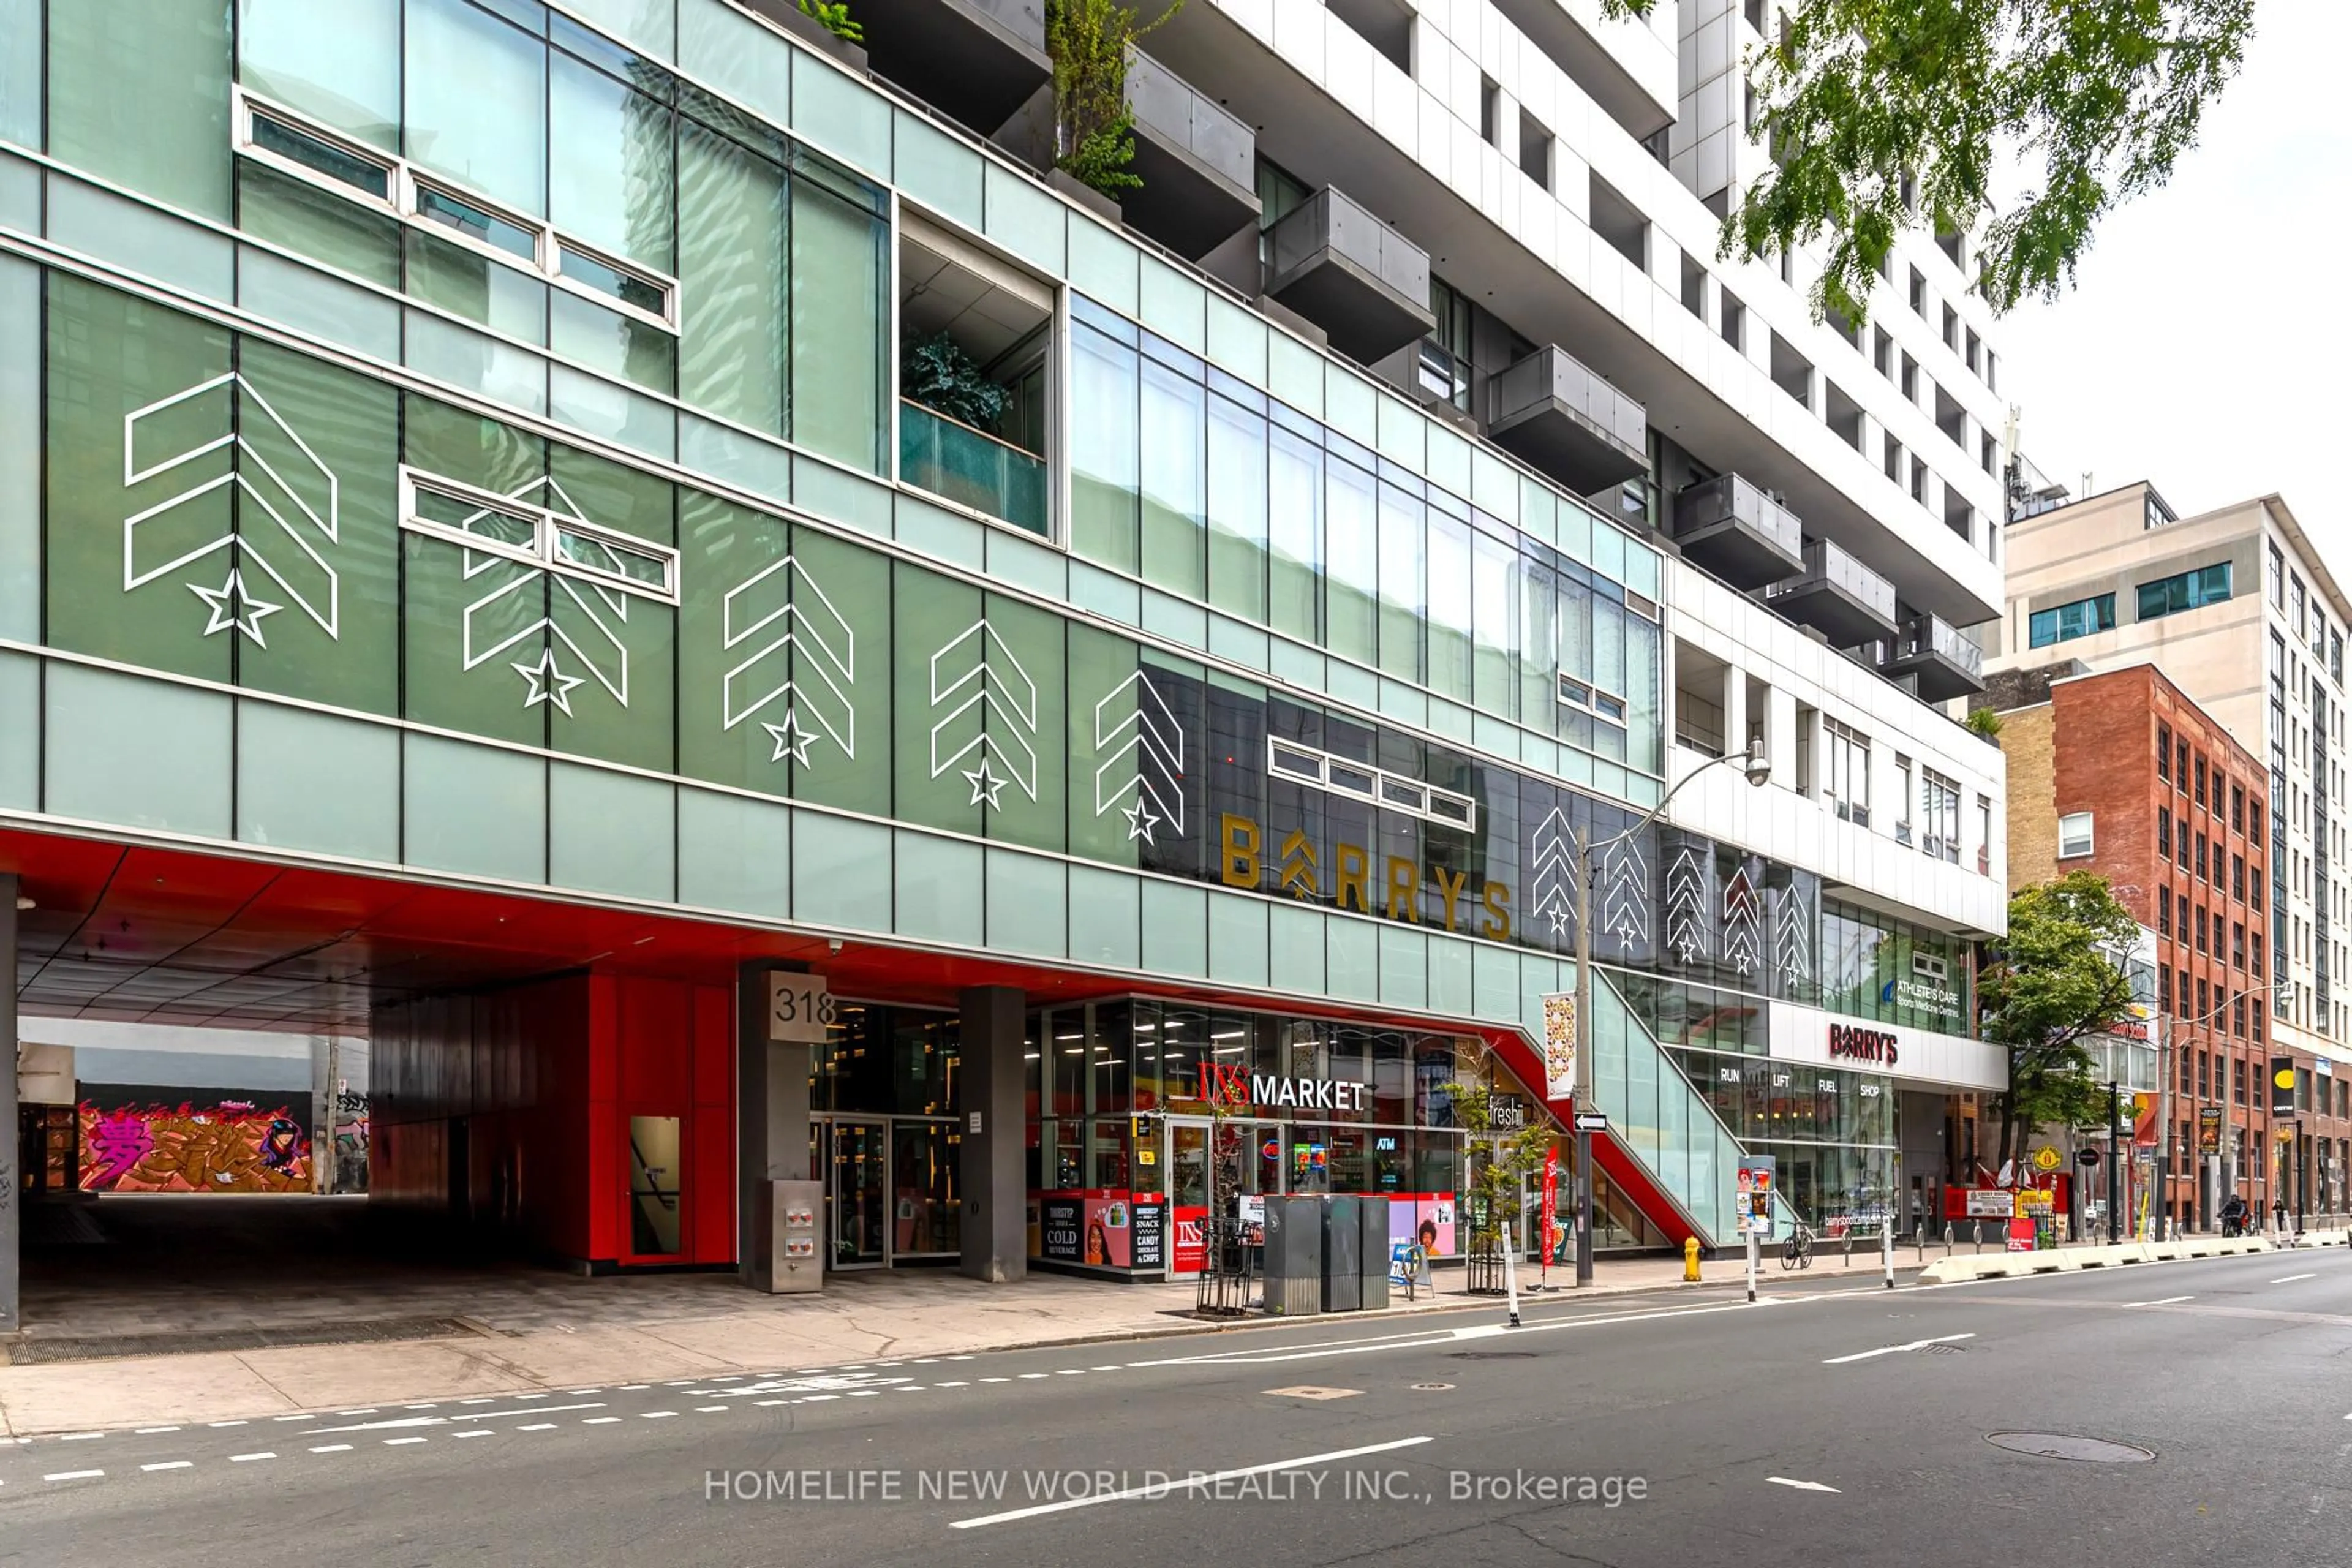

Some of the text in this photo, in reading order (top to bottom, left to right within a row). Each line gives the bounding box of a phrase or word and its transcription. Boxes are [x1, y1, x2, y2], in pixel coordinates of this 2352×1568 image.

[1897, 995, 1914, 1008] Sports
[1939, 990, 1958, 1005] CARE
[775, 988, 837, 1025] 318
[1721, 1068, 1740, 1082] RUN
[1773, 1075, 1789, 1088] LIFT
[1196, 1063, 1365, 1110] INS MARKET
[1819, 1080, 1837, 1093] FUEL
[1861, 1085, 1879, 1097] SHOP
[1377, 1137, 1395, 1150] ATM
[1047, 1231, 1077, 1245] COLD
[1137, 1236, 1159, 1246] CANDY
